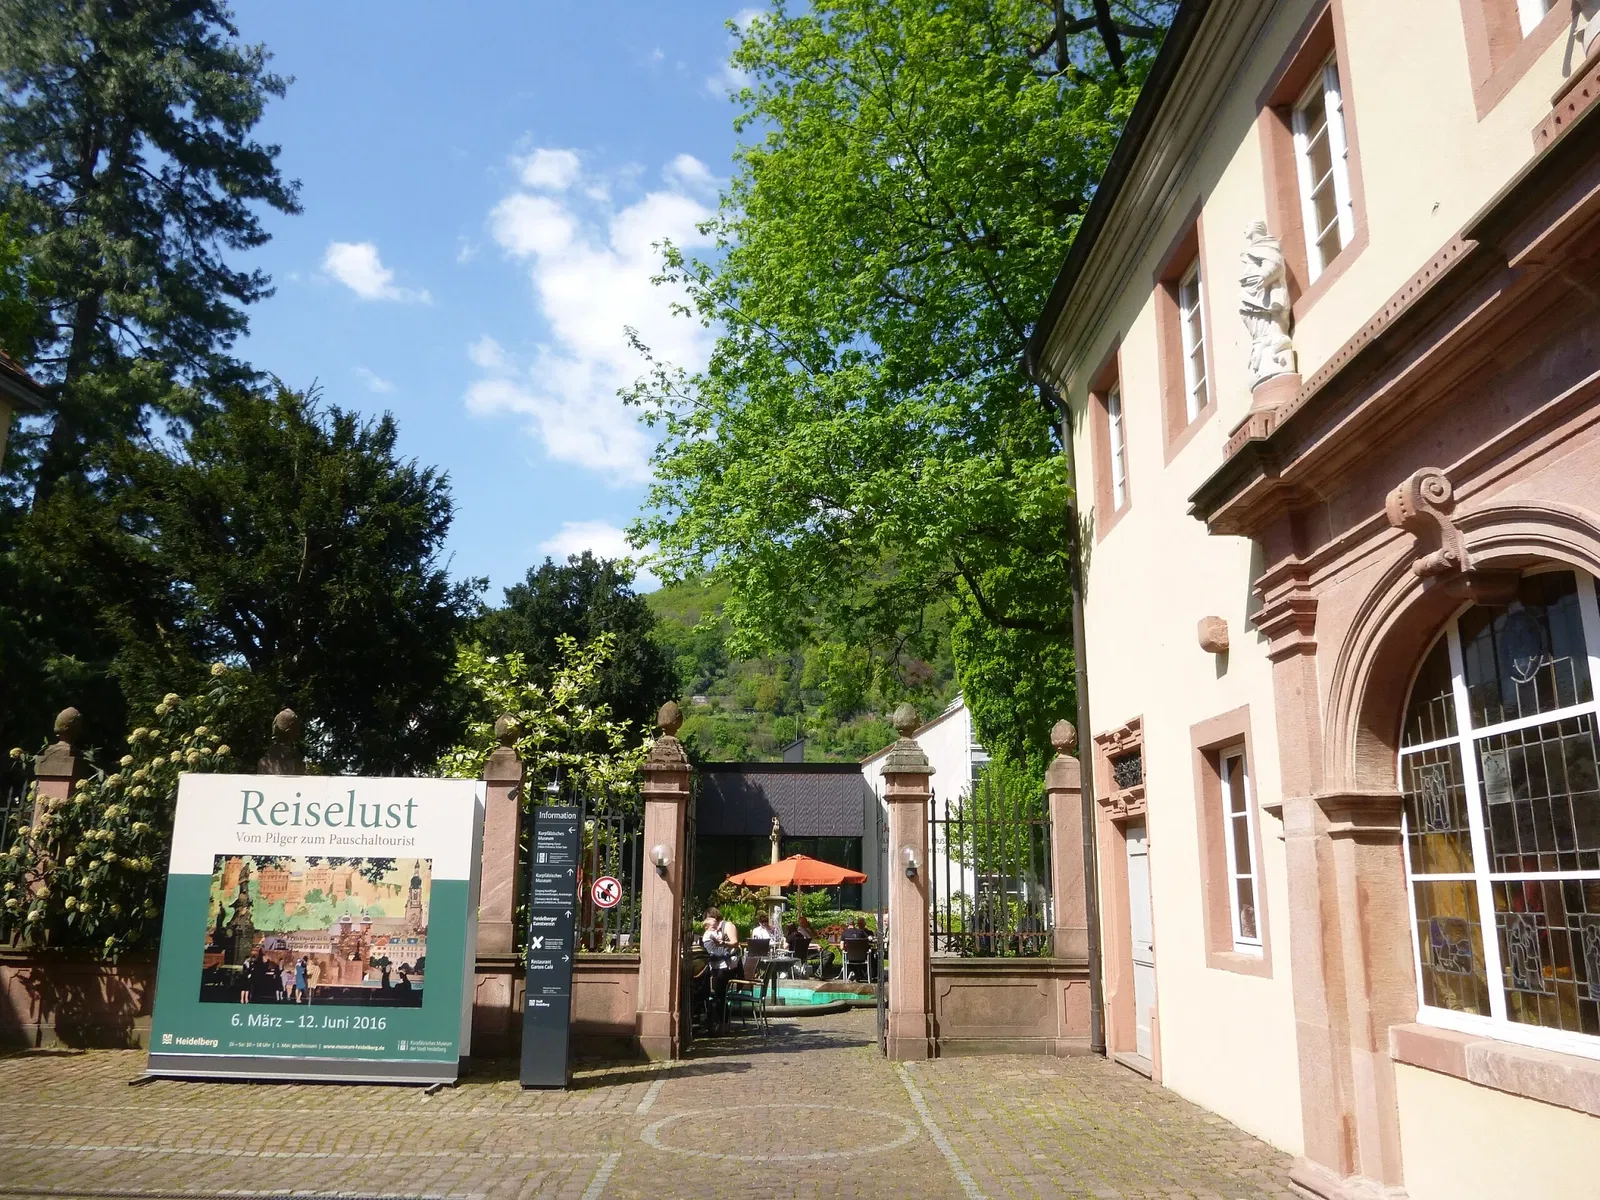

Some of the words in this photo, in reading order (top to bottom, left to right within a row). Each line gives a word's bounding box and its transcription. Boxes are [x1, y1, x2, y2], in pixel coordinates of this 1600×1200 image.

[237, 789, 418, 829] Reiselust
[538, 811, 577, 820] Information
[236, 832, 261, 843] Vom
[266, 832, 298, 847] Pilger
[300, 836, 325, 844] zum
[329, 834, 416, 847] Pauschaltourist
[231, 1013, 243, 1026] 6.
[248, 1014, 282, 1027] März
[298, 1015, 318, 1028] 12.
[322, 1016, 348, 1029] Juni
[353, 1016, 387, 1030] 2016
[175, 1036, 219, 1048] Heidelberg
